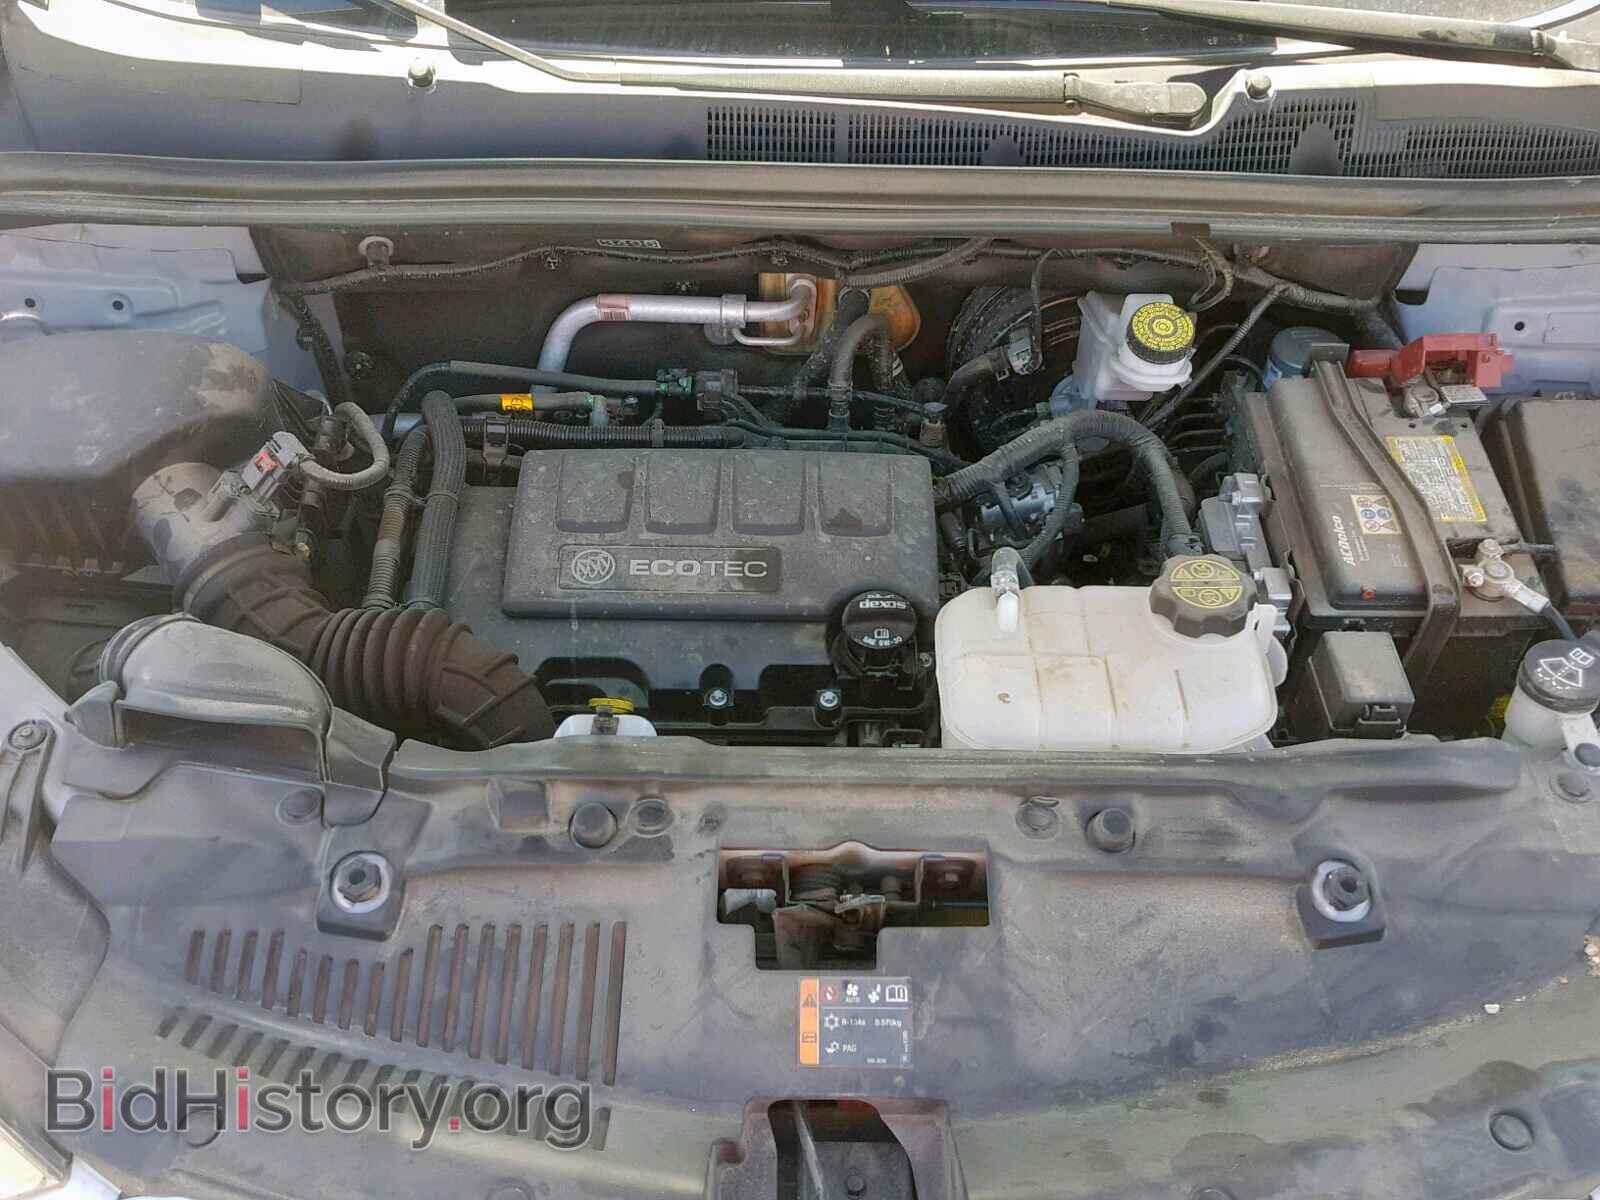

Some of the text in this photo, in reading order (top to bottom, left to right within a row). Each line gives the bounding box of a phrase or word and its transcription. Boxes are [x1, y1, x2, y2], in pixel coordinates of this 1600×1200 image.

[628, 559, 768, 577] ECOTEC
[859, 599, 907, 609] dexos
[842, 1043, 857, 1053] PAG
